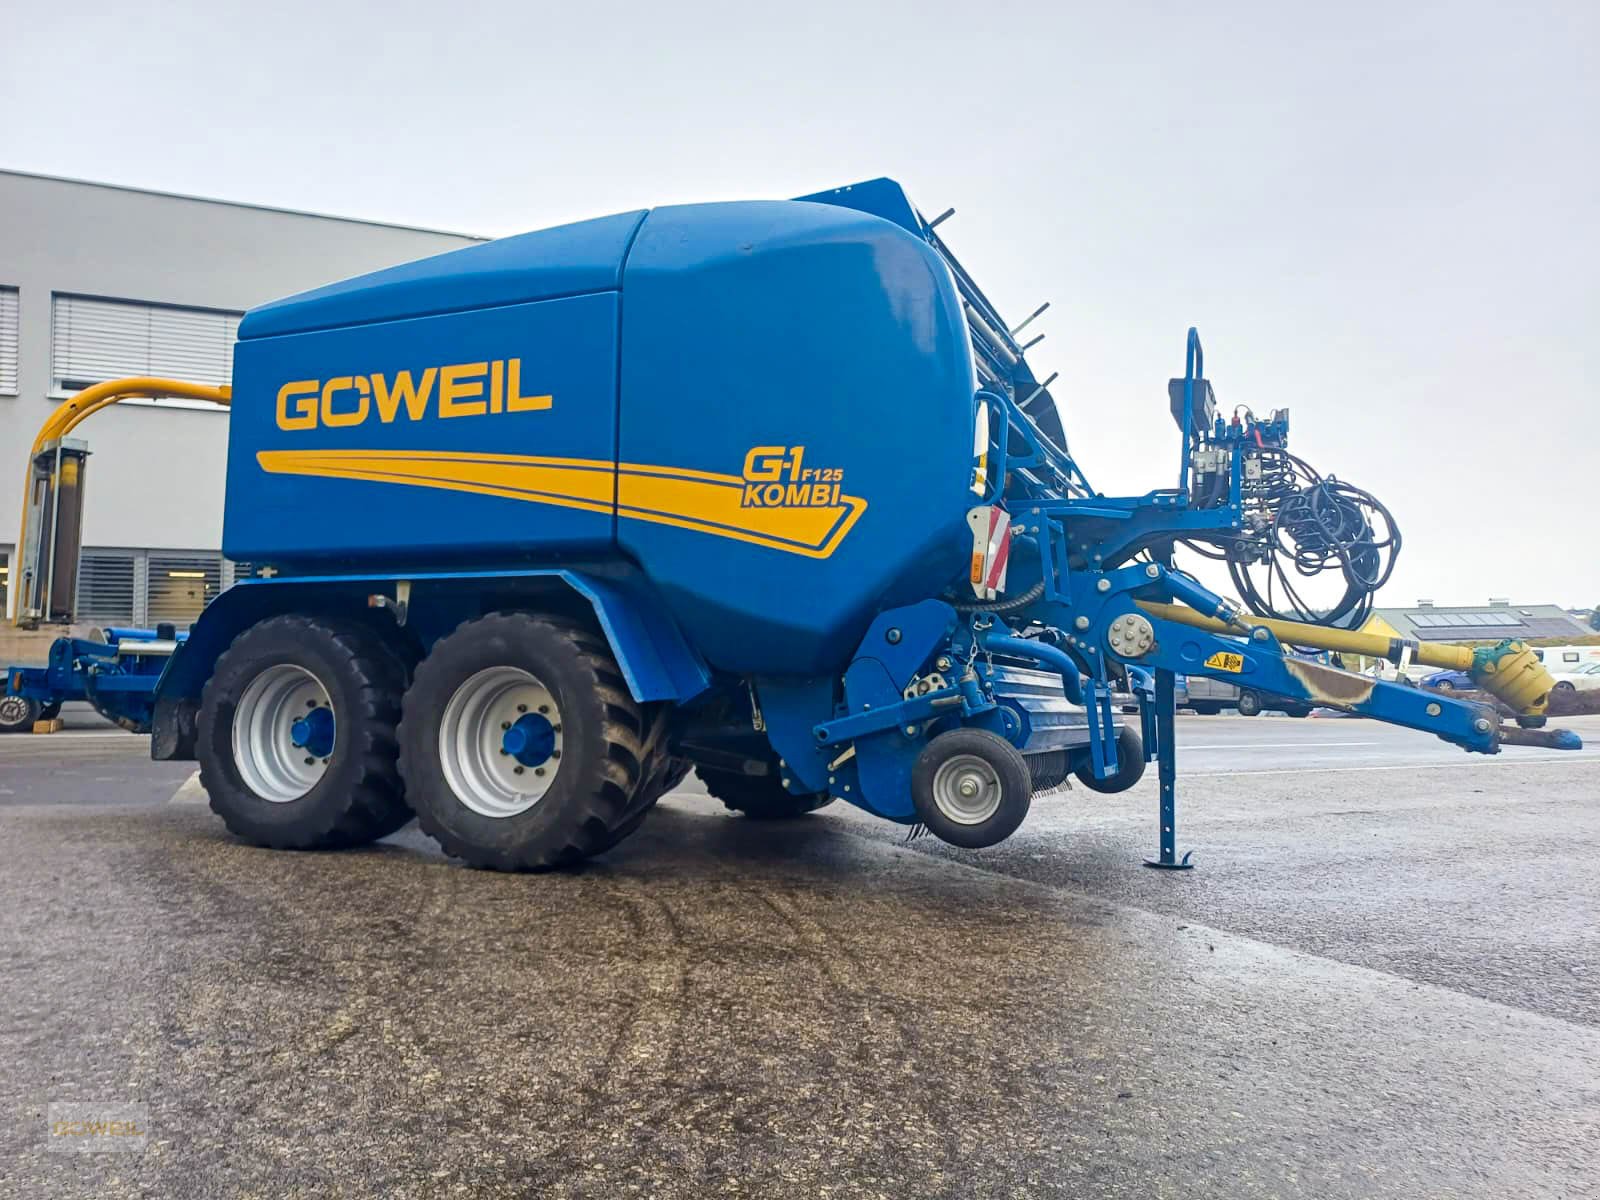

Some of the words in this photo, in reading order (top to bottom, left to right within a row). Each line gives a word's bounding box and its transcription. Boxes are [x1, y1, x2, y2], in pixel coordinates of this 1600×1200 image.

[743, 446, 805, 481] G-1
[801, 469, 843, 481] F125
[743, 484, 841, 506] KOMBI
